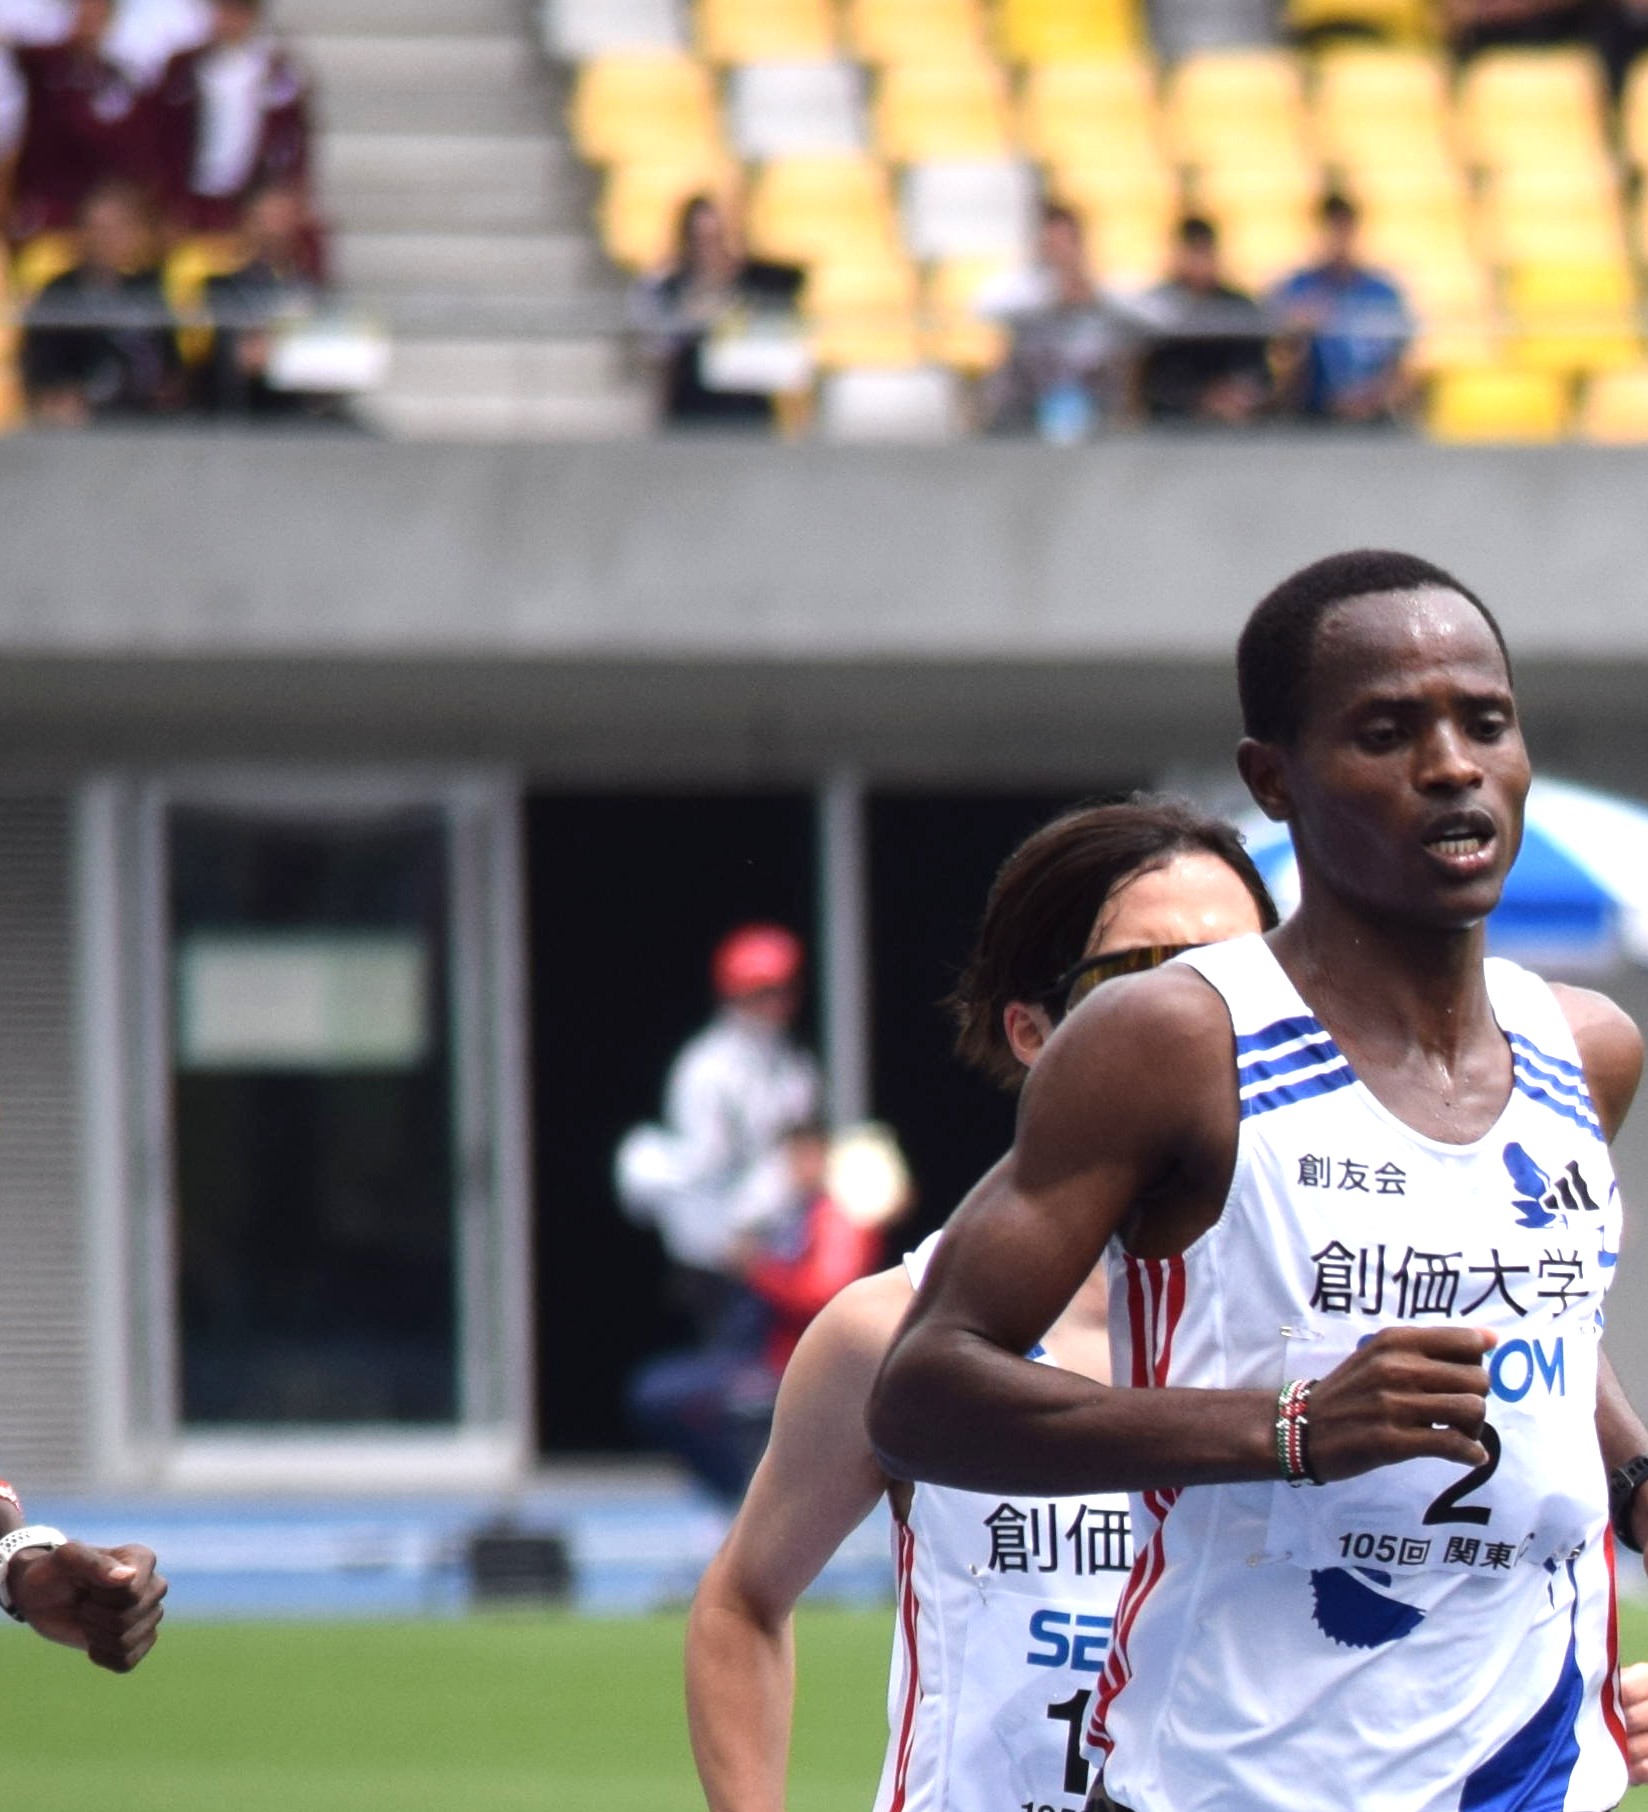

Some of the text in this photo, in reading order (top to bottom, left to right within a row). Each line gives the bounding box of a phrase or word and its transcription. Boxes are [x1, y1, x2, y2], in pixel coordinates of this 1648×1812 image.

[1297, 1153, 1406, 1196] 創友会
[1309, 1240, 1590, 1318] 創価大学
[1422, 1420, 1502, 1526] 2
[984, 1502, 1134, 1576] 創価
[1338, 1532, 1432, 1567] 105回
